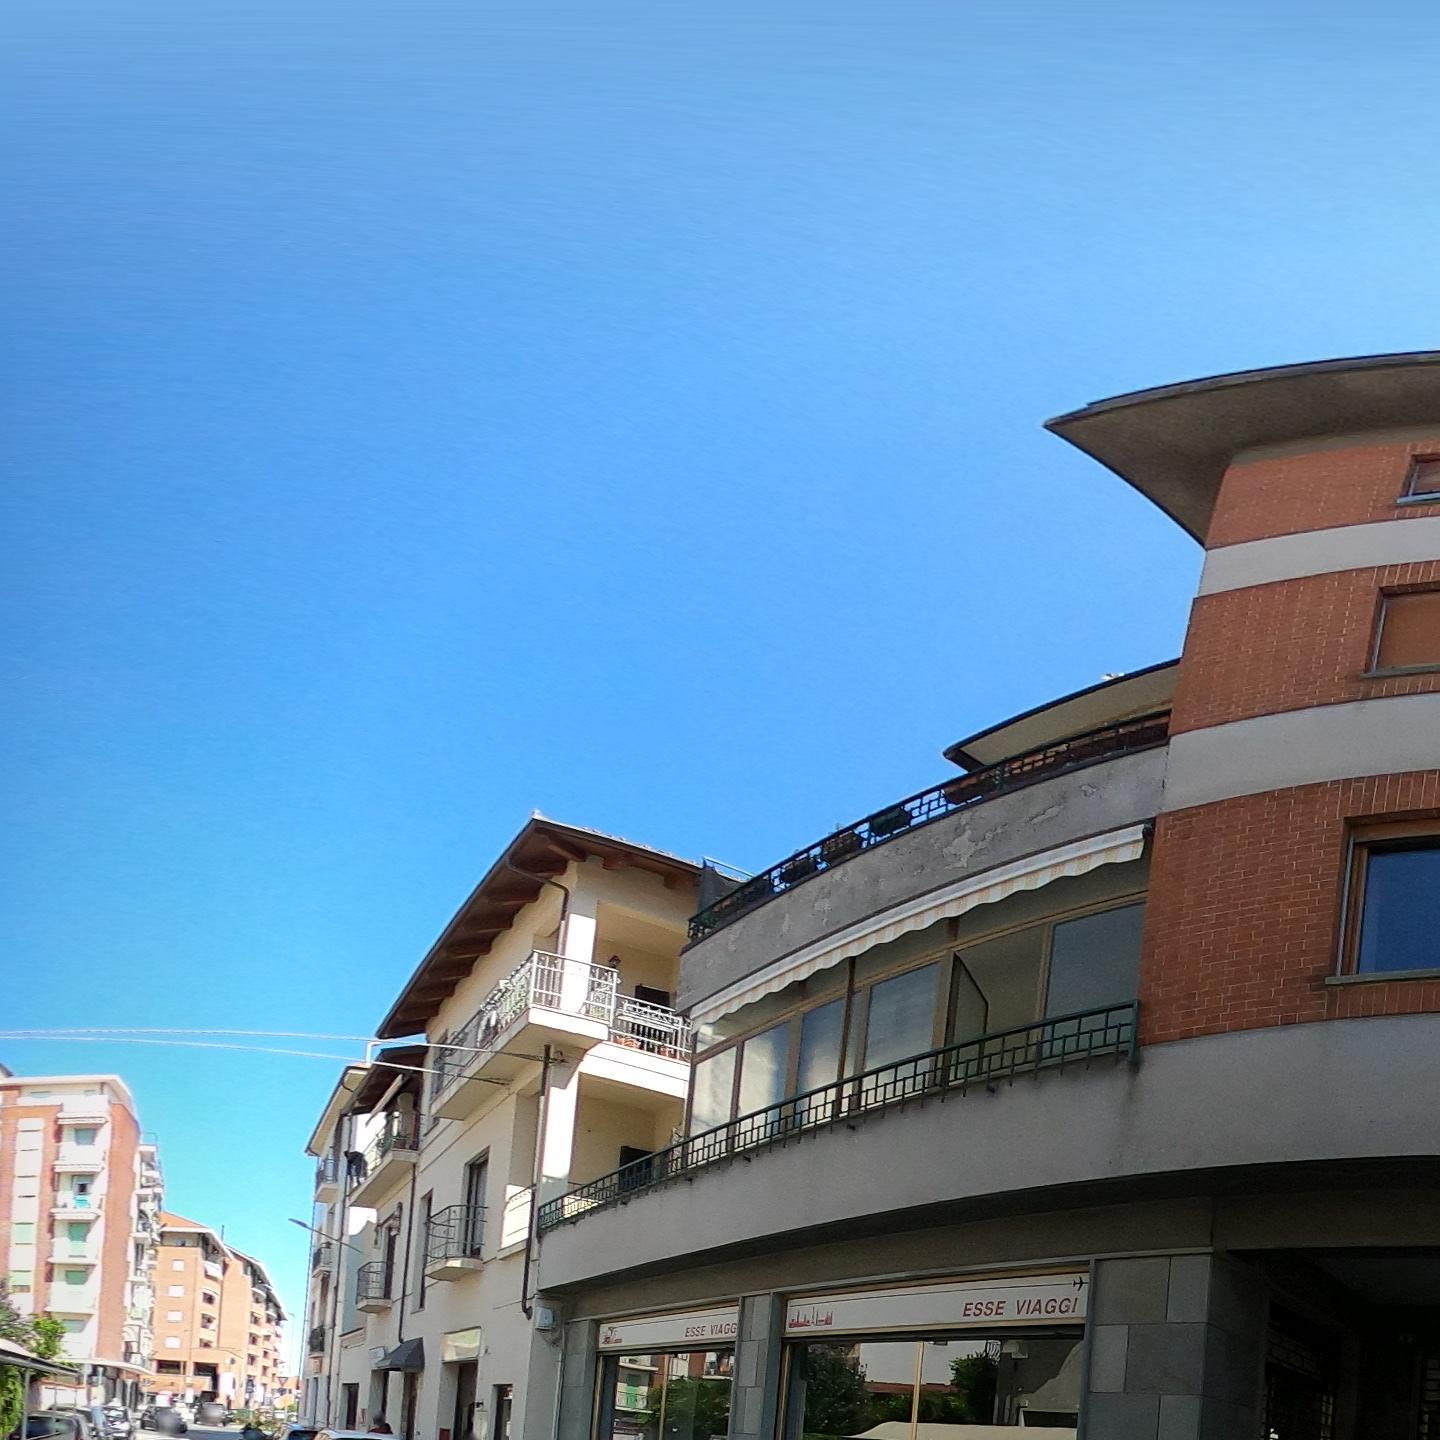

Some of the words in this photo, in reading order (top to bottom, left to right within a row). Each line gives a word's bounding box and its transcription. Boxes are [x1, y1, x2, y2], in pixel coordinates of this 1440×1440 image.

[962, 1300, 1007, 1317] ESSE
[1016, 1297, 1078, 1315] VIAGGI
[684, 1325, 707, 1338] ESSE
